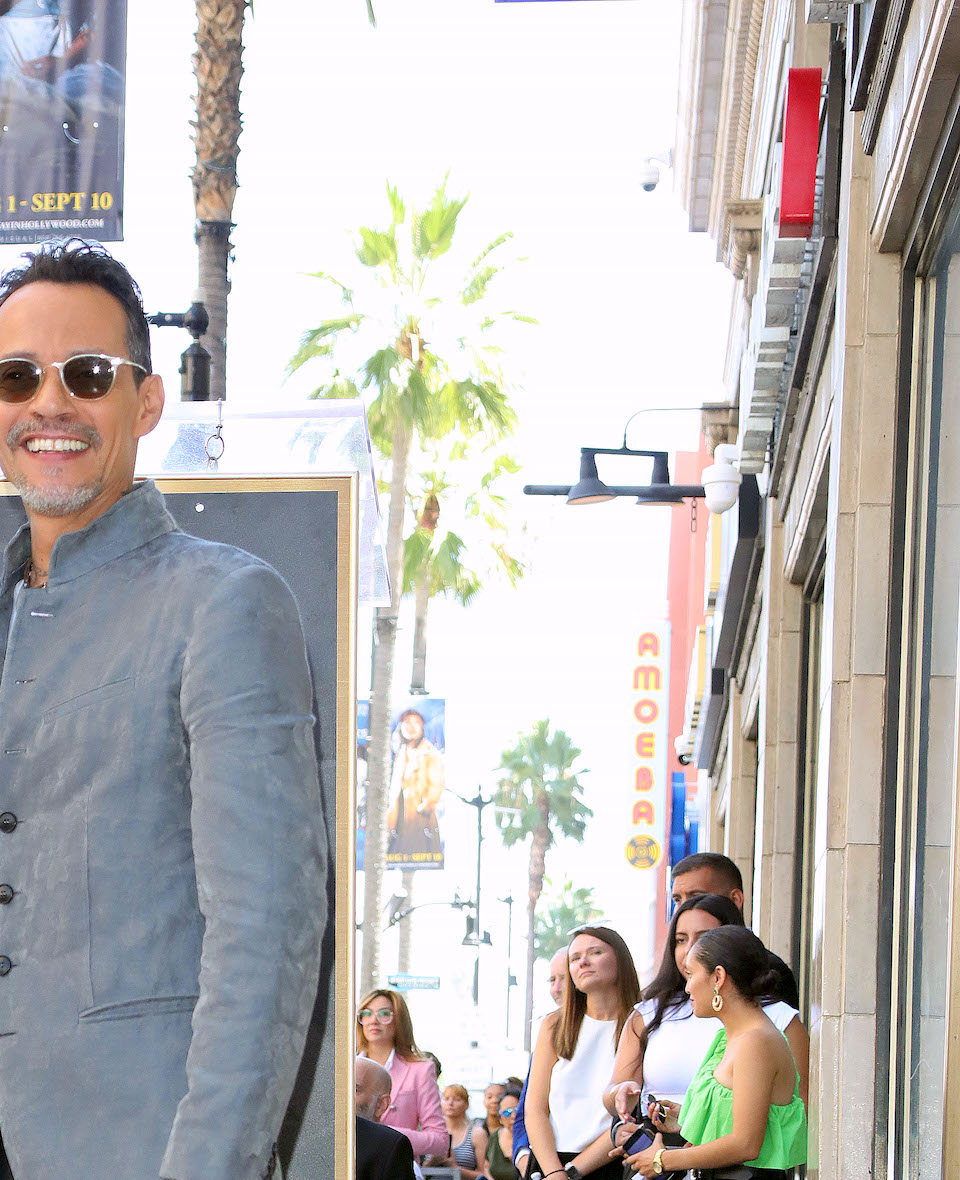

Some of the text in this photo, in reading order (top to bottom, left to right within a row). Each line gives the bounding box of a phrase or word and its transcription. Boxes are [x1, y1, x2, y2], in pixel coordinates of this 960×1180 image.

[8, 195, 16, 213] 1
[31, 192, 86, 212] SEPT
[91, 192, 113, 210] 10
[632, 632, 662, 826] AMOEBA
